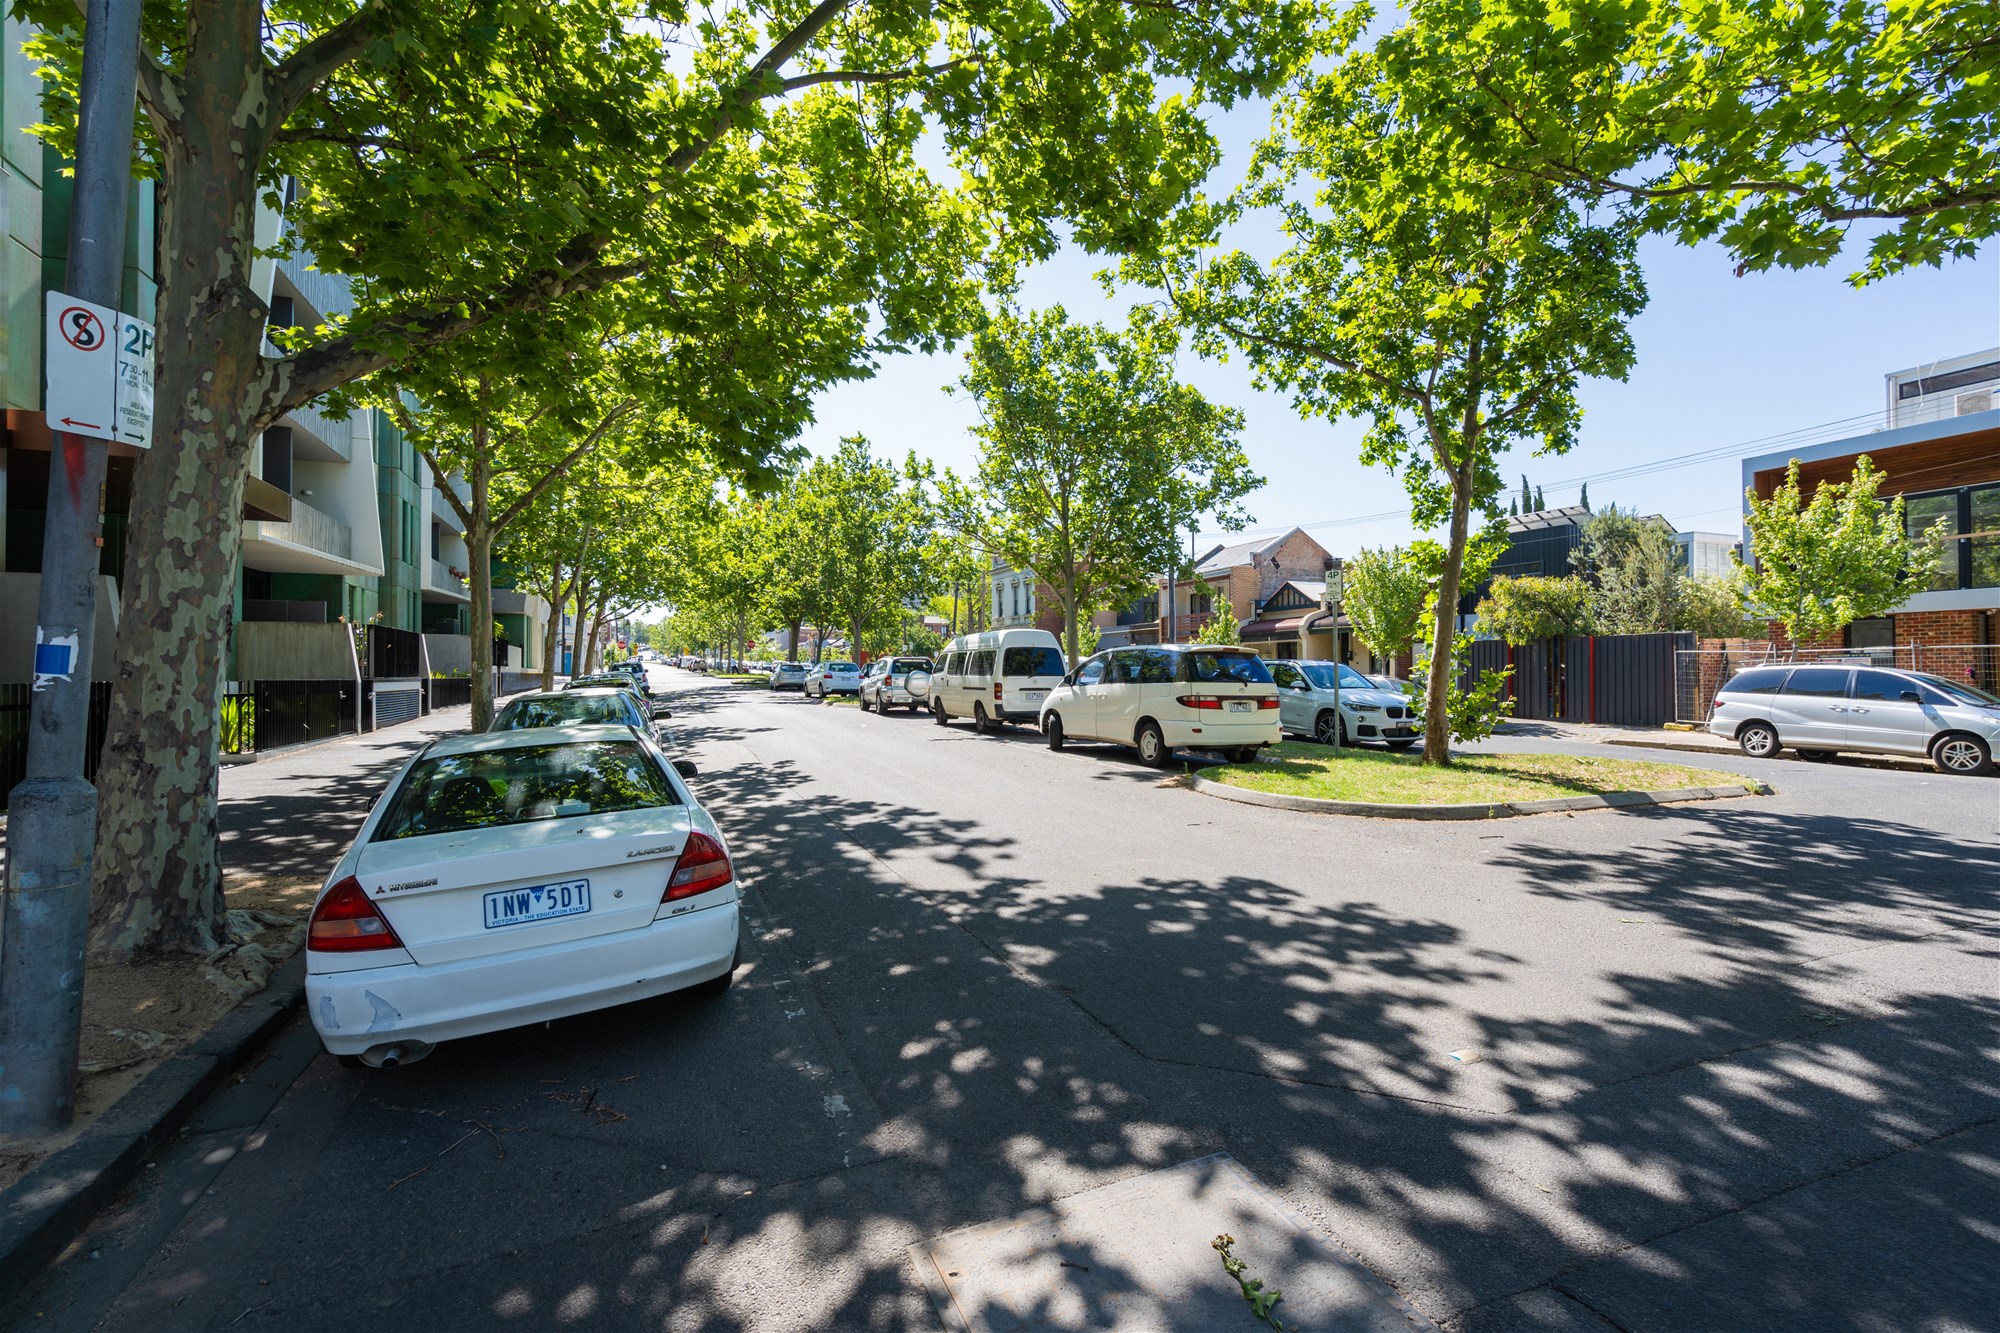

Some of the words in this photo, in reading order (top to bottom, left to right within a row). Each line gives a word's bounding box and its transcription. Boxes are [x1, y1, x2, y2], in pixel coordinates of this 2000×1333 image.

[124, 324, 154, 358] 2P
[1327, 571, 1339, 579] 4P
[626, 845, 676, 858] LANCER
[389, 878, 438, 892] MITSUBISHI
[491, 917, 519, 926] VICTORIA
[536, 909, 568, 918] EDUCATION
